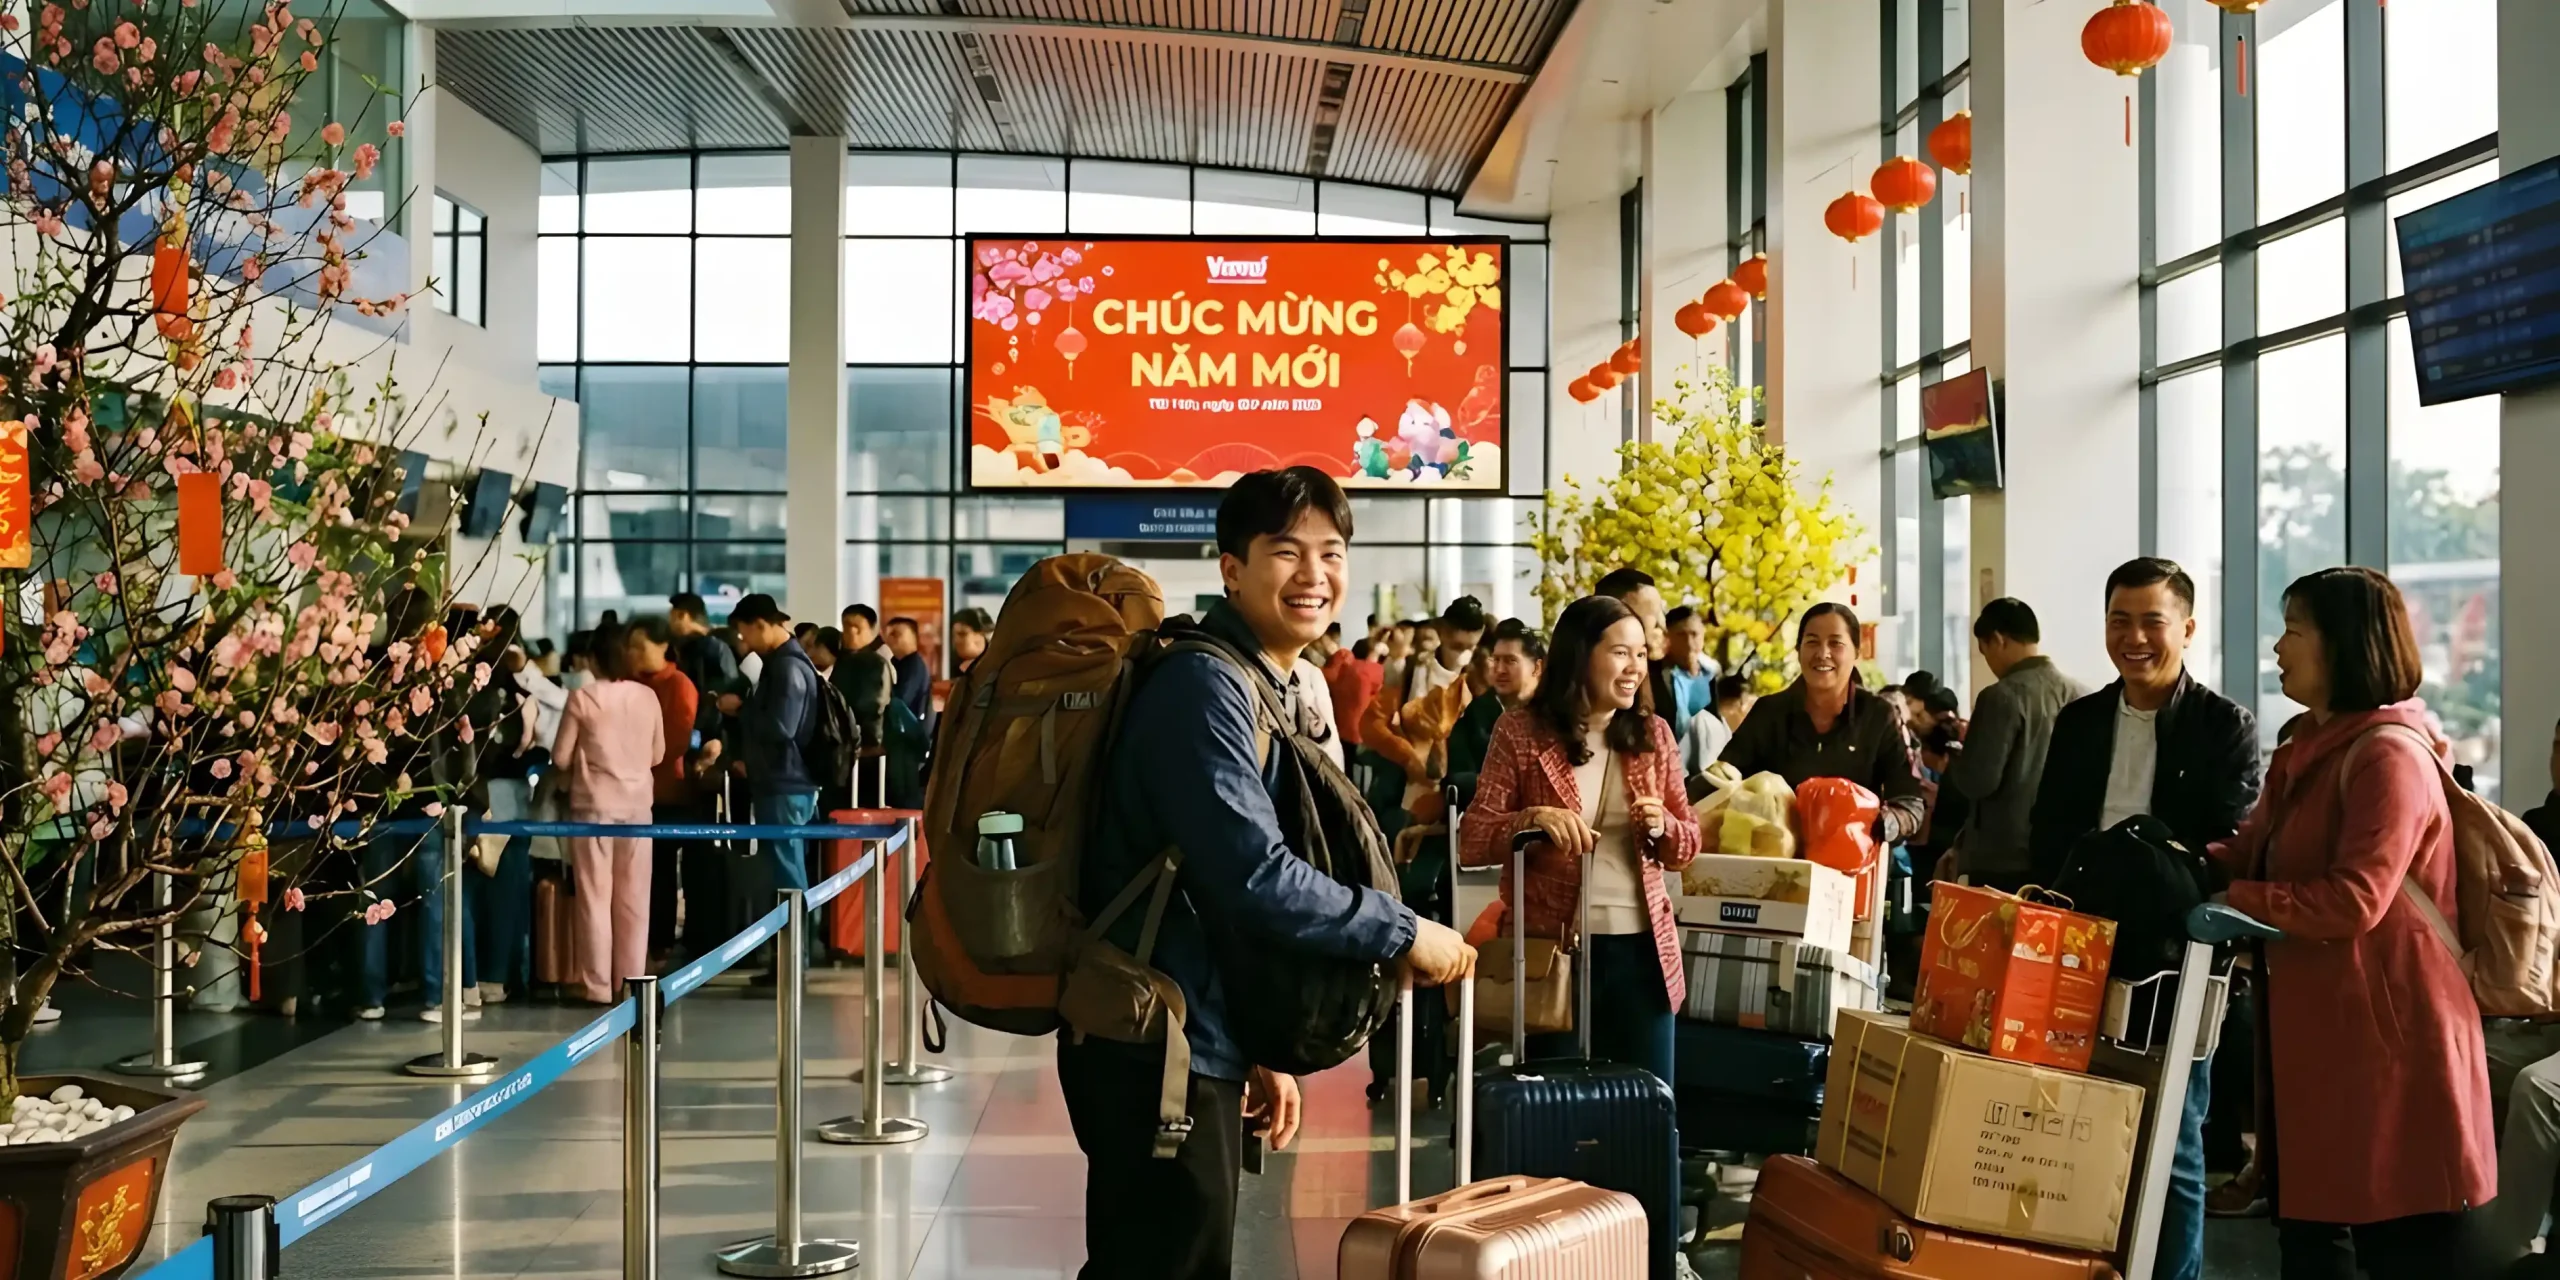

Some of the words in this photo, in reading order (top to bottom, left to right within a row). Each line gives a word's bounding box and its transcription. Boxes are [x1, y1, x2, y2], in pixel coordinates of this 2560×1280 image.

[1093, 290, 1224, 335] CHÚC
[1237, 290, 1378, 336] MỪNG
[1131, 342, 1236, 388] NĂM
[1252, 344, 1340, 388] MỚI
